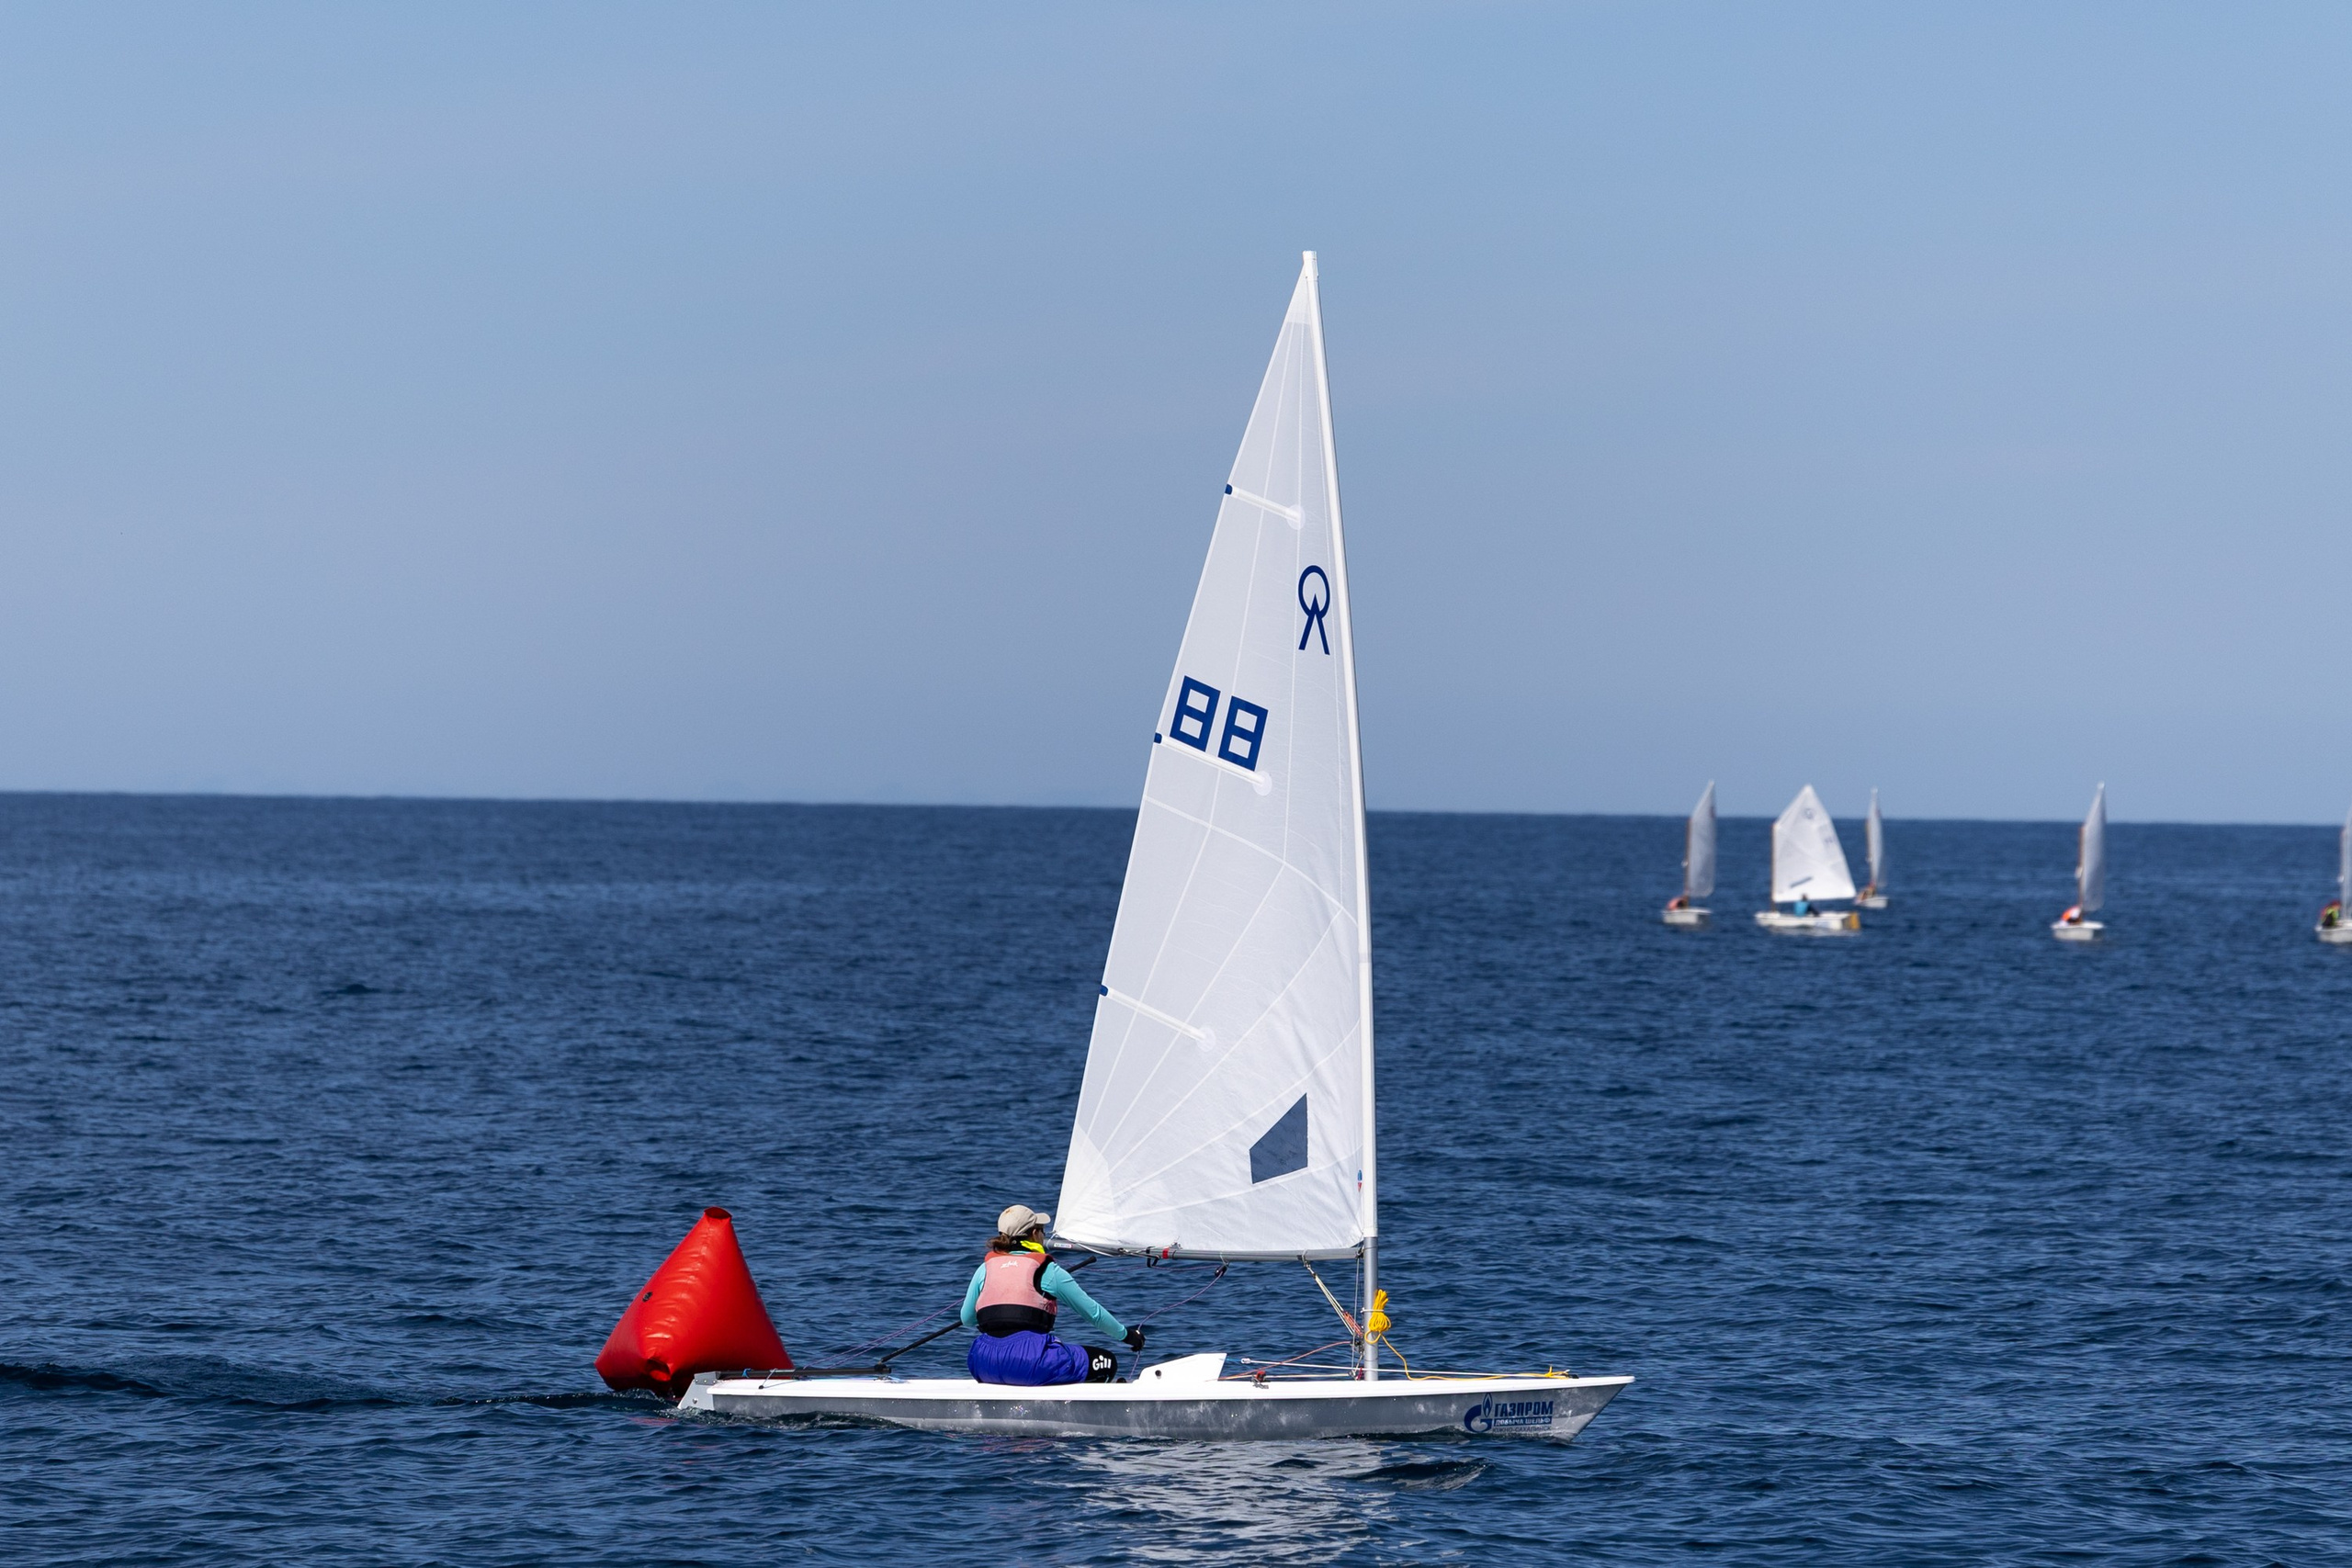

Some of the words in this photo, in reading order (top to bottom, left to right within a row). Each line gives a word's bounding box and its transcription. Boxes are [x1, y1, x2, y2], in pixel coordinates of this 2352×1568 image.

[1169, 675, 1269, 772] 88
[1092, 1355, 1112, 1371] Gill
[1494, 1401, 1554, 1416] ГАЗПРОМ
